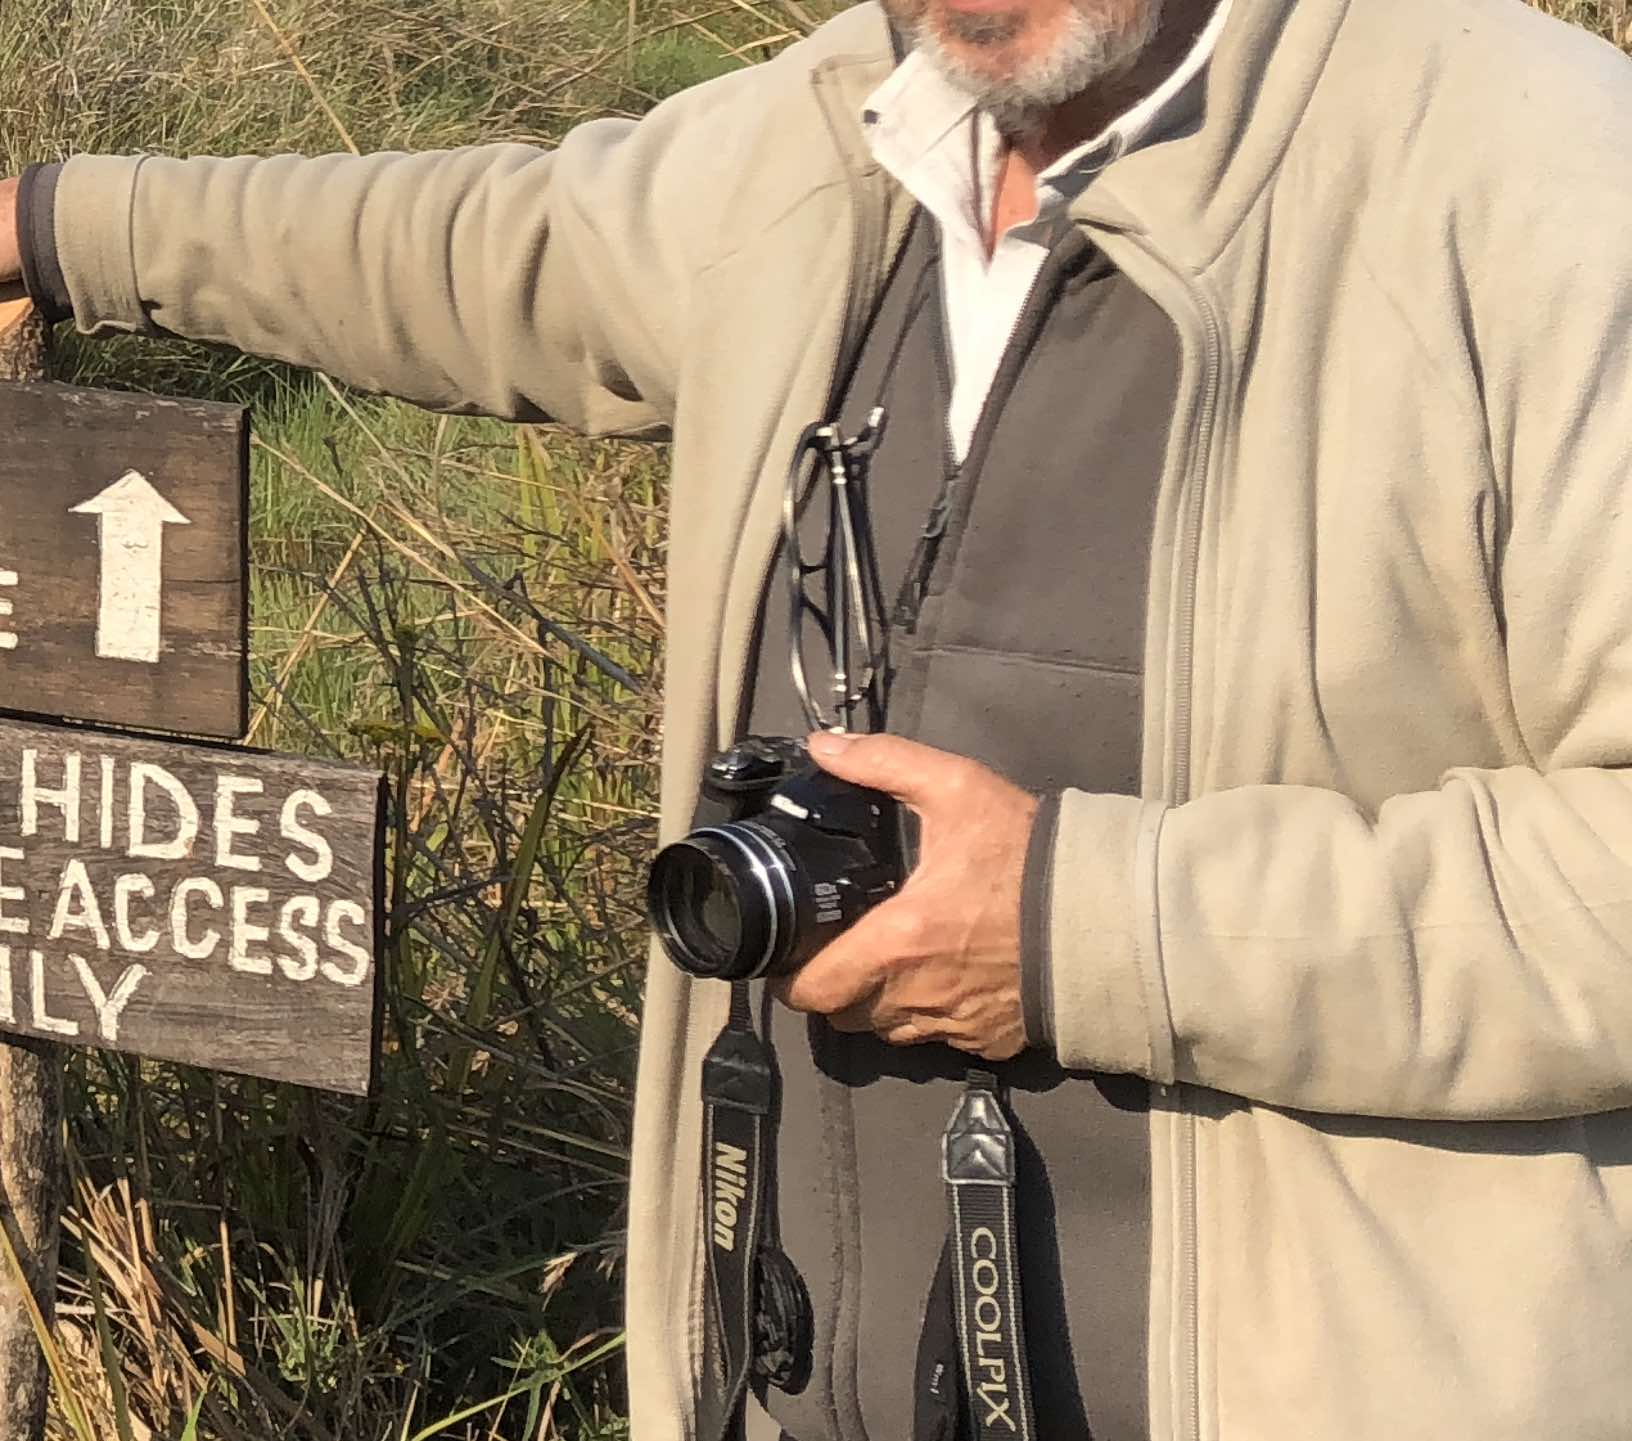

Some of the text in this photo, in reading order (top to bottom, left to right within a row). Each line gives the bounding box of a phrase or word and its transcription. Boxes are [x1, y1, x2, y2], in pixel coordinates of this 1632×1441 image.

[19, 745, 335, 883] HIDES
[46, 857, 371, 988] ACCESS
[714, 1141, 747, 1251] Nikon
[971, 1227, 1016, 1432] COOLPIX
